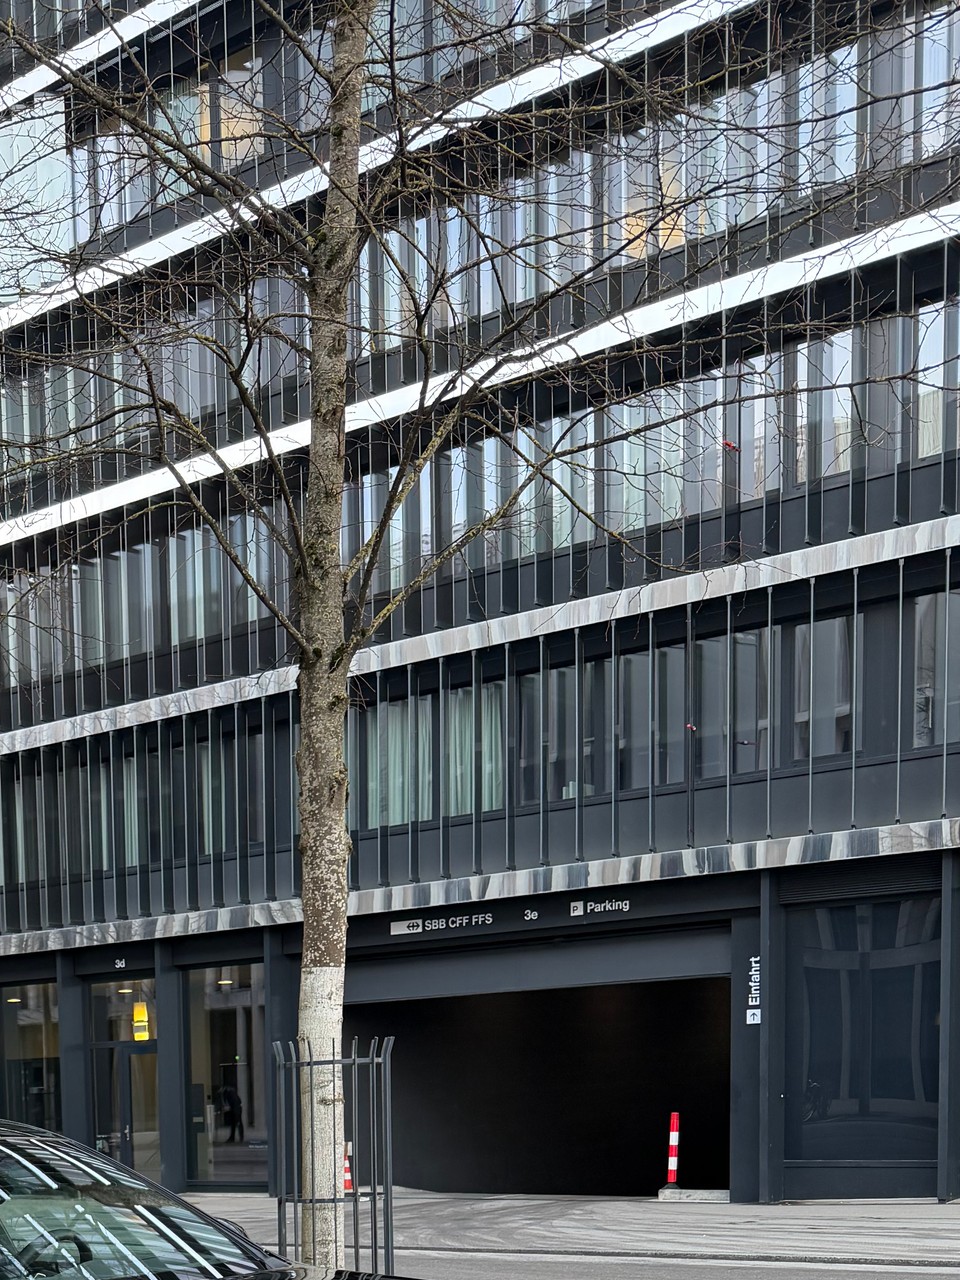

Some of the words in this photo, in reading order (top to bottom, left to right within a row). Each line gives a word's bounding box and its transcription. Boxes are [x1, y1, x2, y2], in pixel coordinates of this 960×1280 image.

[587, 899, 630, 913] Parking
[524, 909, 539, 920] 3e
[424, 919, 446, 931] SBB
[448, 915, 469, 928] CFF
[472, 913, 493, 926] FFS
[115, 959, 126, 969] 3d
[748, 955, 761, 1006] Einfahrt
